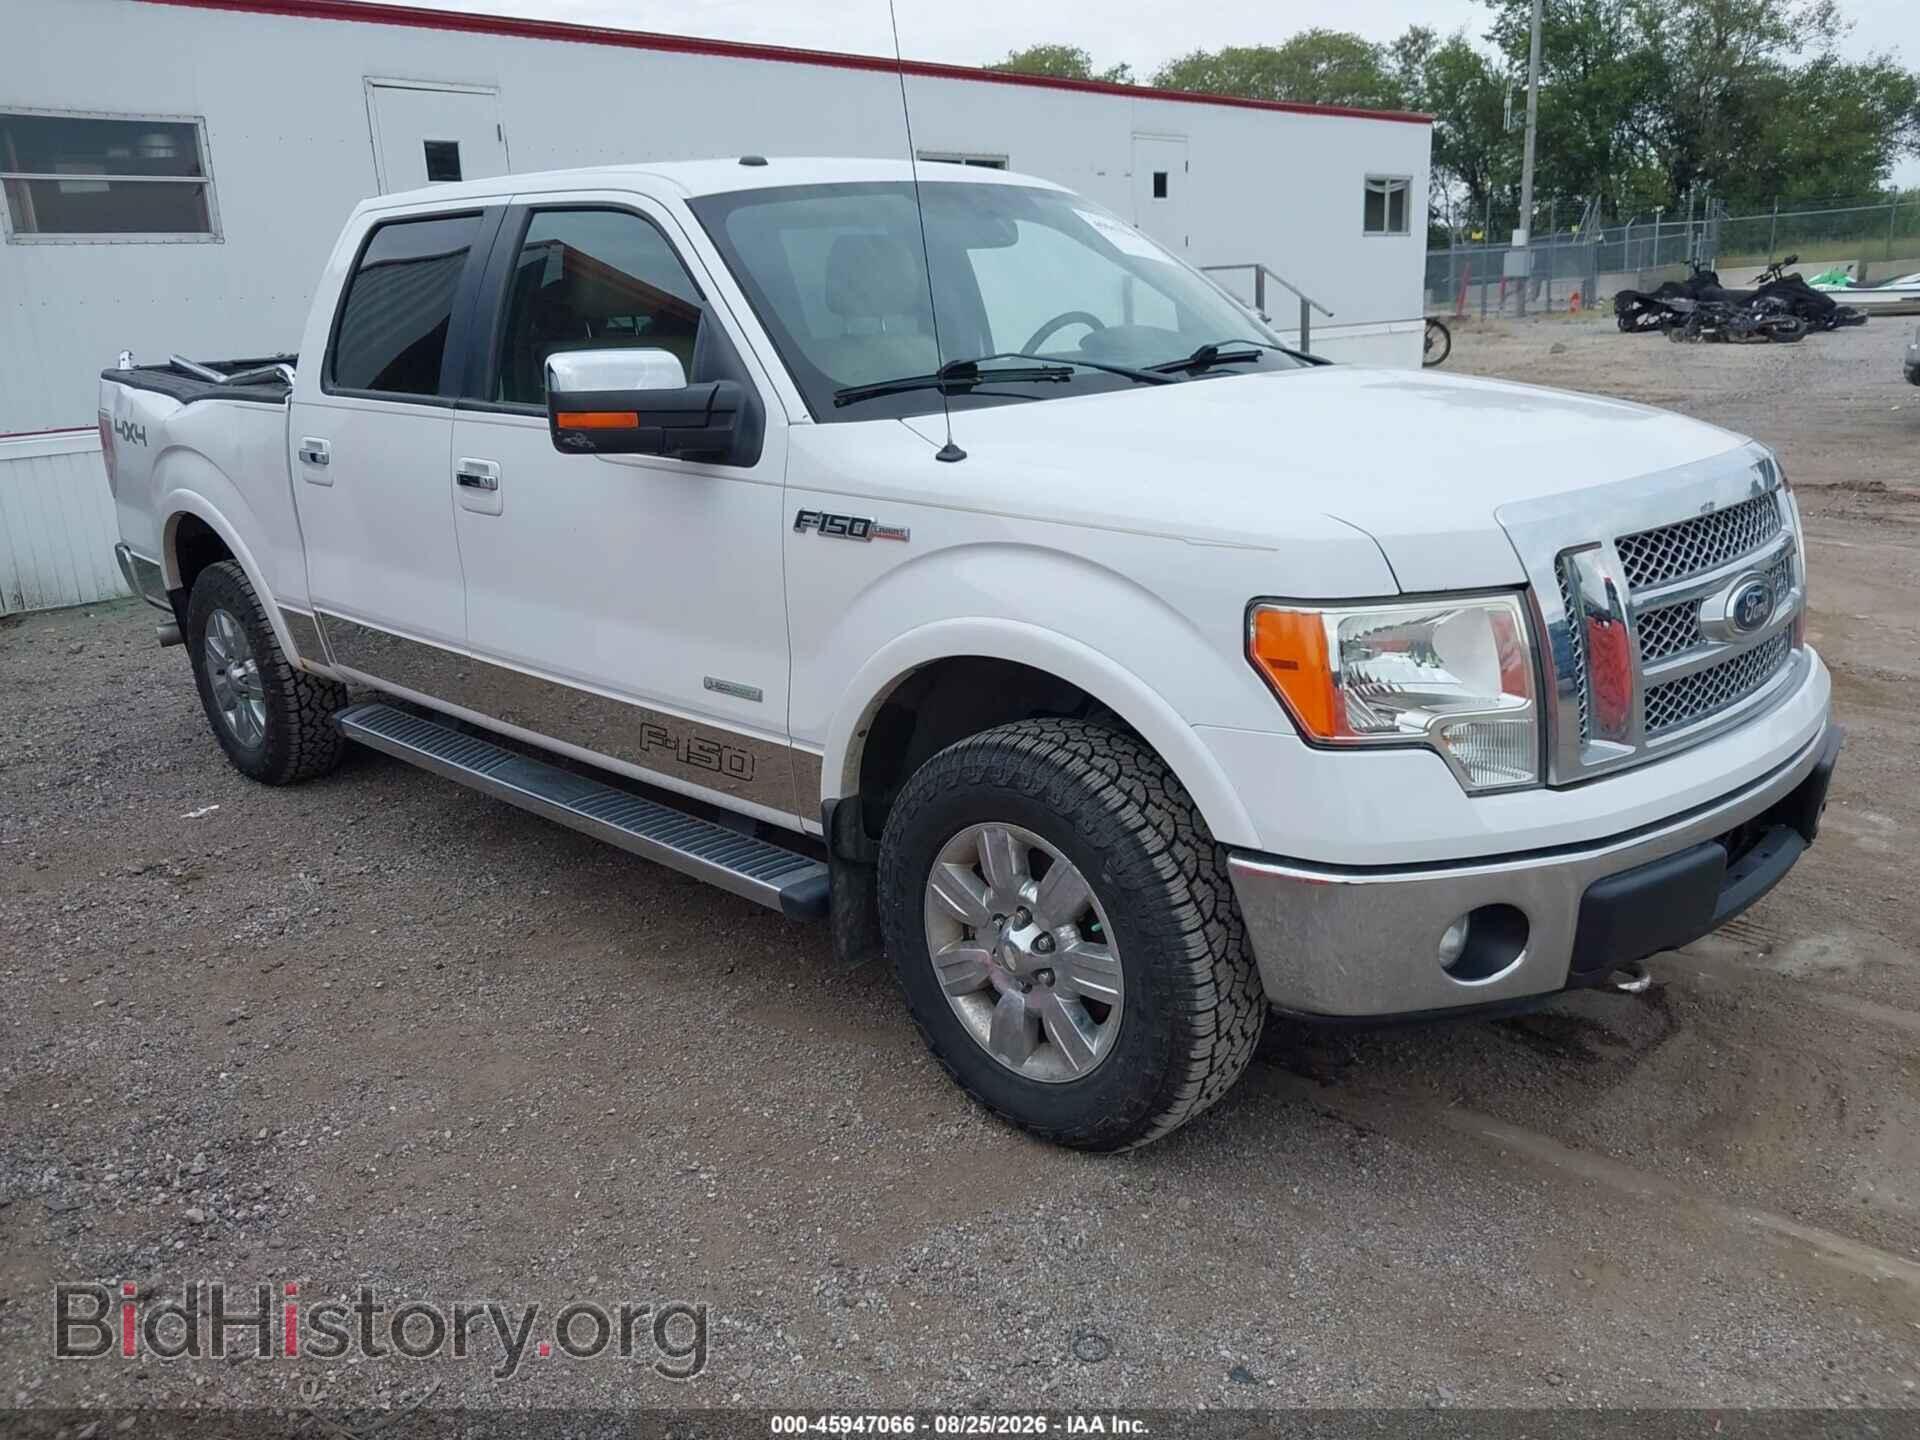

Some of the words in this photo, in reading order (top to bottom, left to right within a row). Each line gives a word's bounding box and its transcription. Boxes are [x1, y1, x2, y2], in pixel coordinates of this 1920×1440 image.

[794, 509, 872, 541] F-150
[1745, 591, 1769, 622] Ford
[640, 722, 755, 781] F-150
